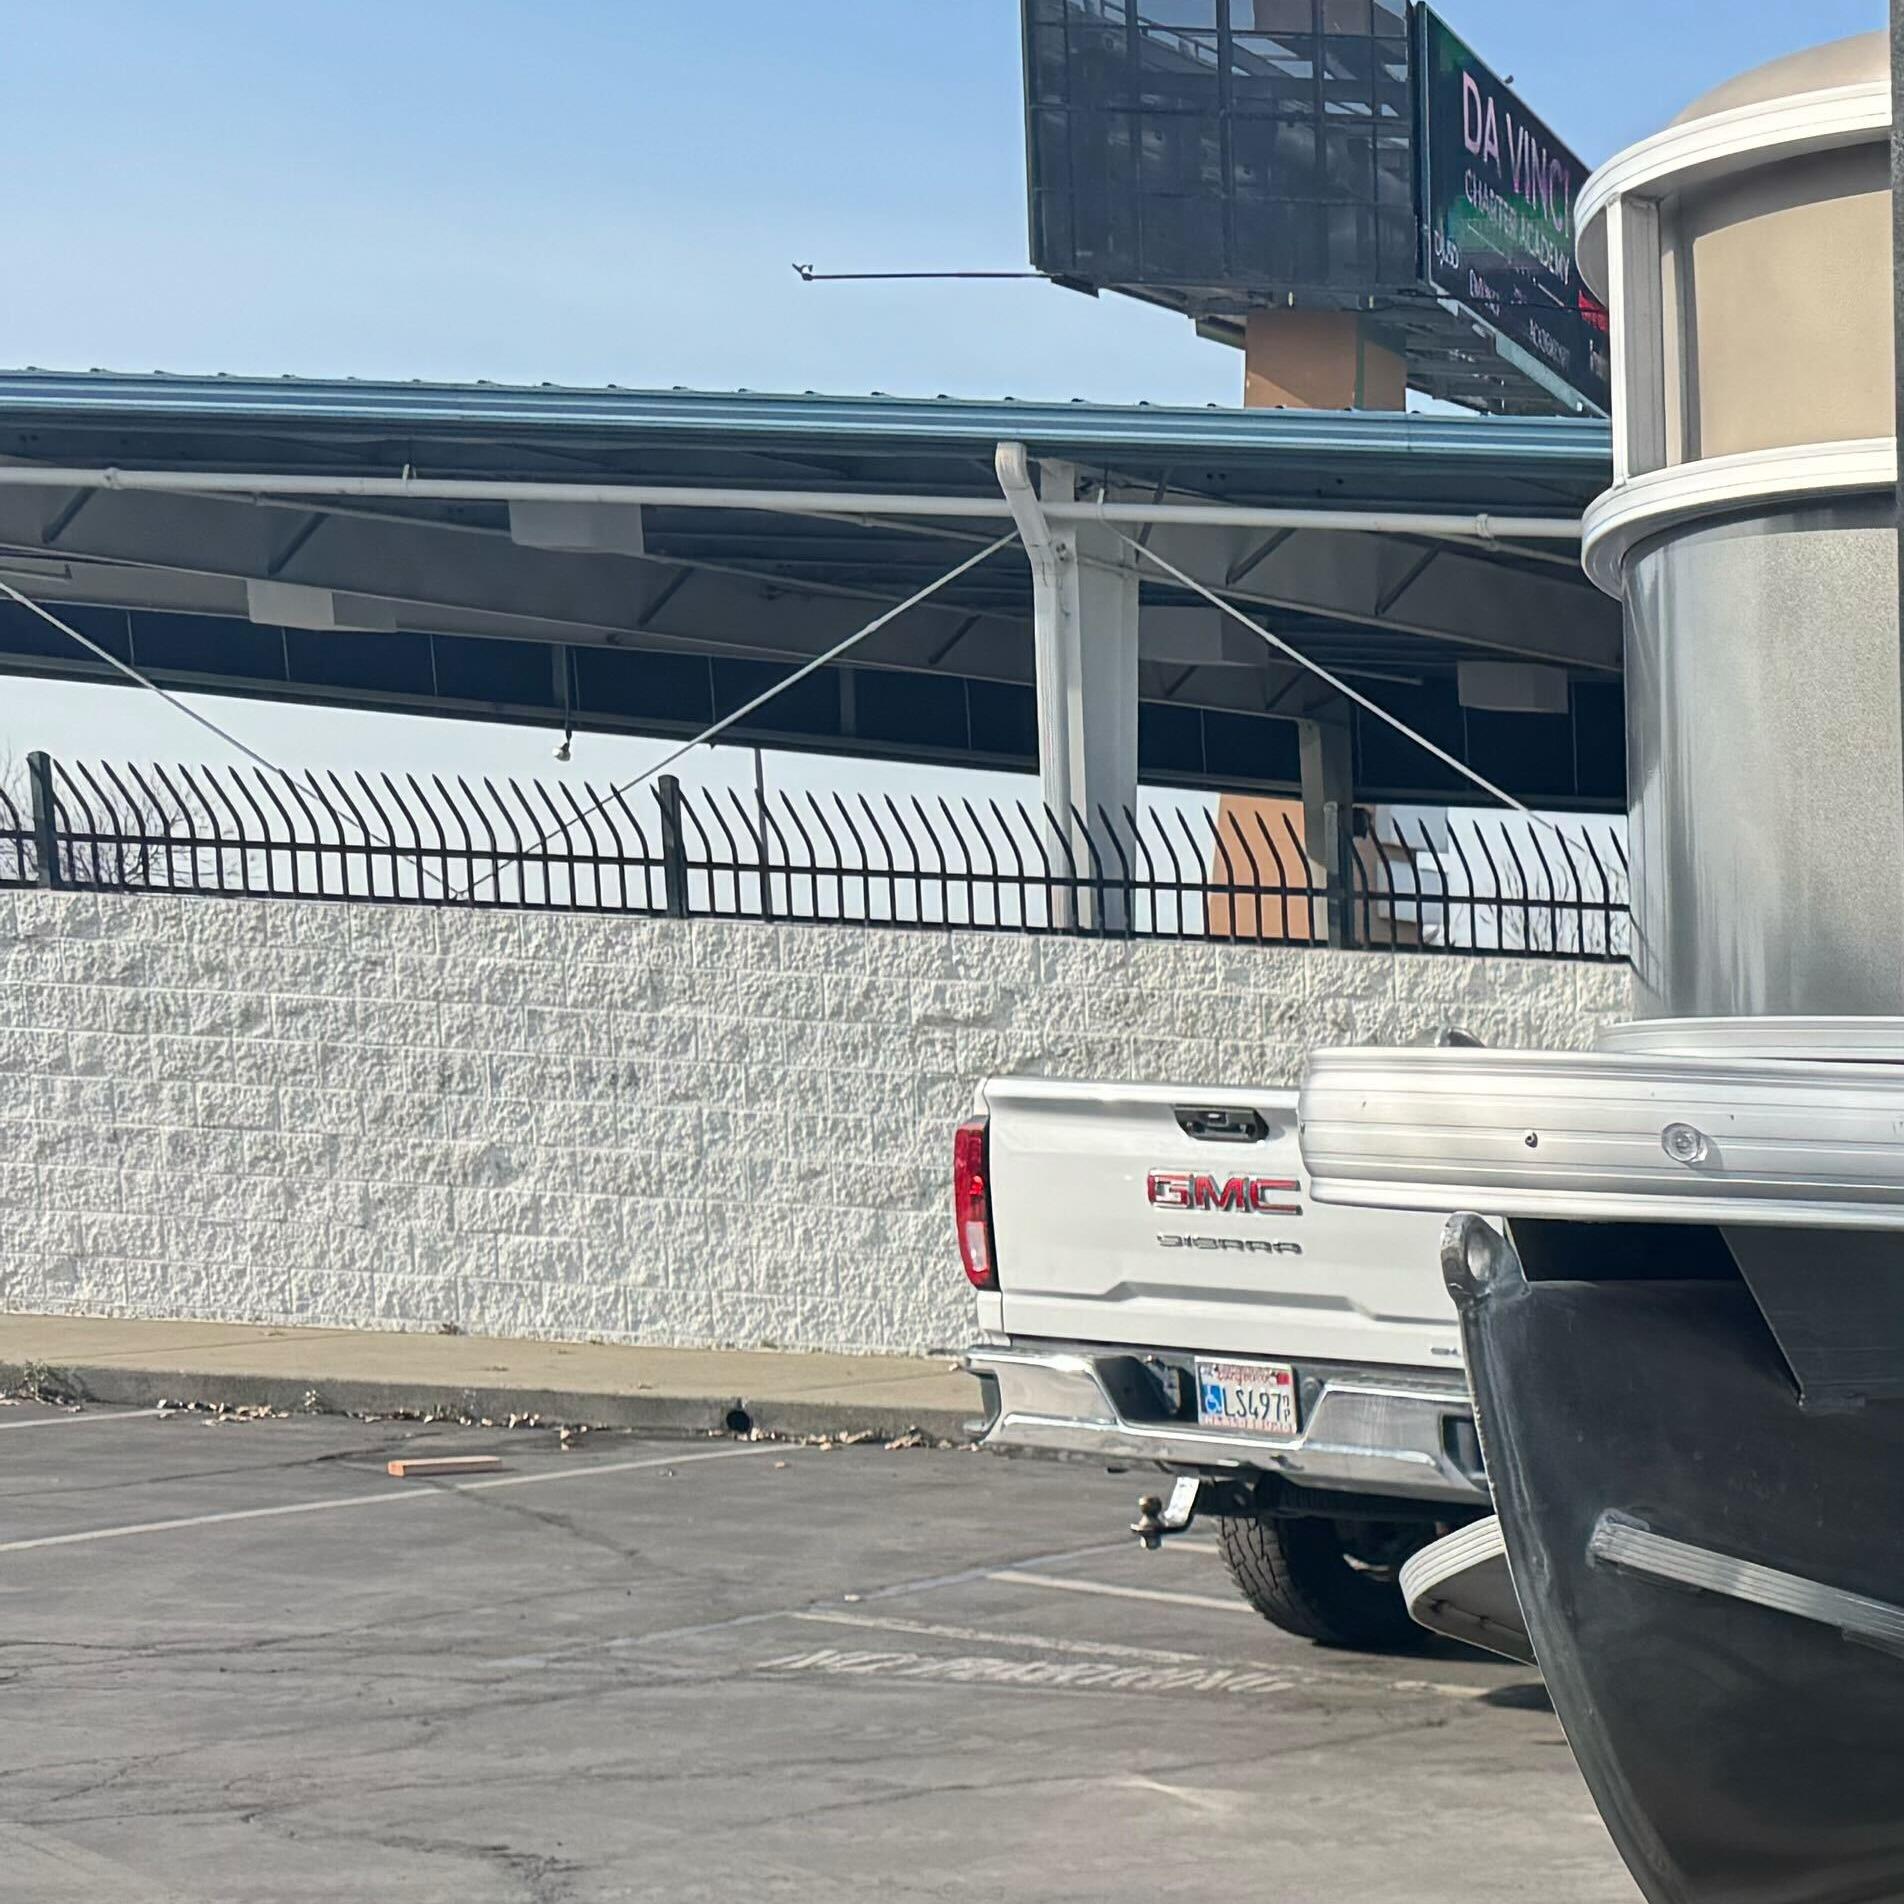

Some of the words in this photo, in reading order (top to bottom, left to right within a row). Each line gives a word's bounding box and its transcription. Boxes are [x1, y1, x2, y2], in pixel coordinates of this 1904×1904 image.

[1463, 70, 1502, 180] DA
[1506, 112, 1569, 239] VINCI
[1464, 167, 1517, 242] CHARTER
[1519, 213, 1570, 286] ACADEMY
[1147, 1168, 1303, 1216] GMC
[1156, 1234, 1303, 1255] SIERRA
